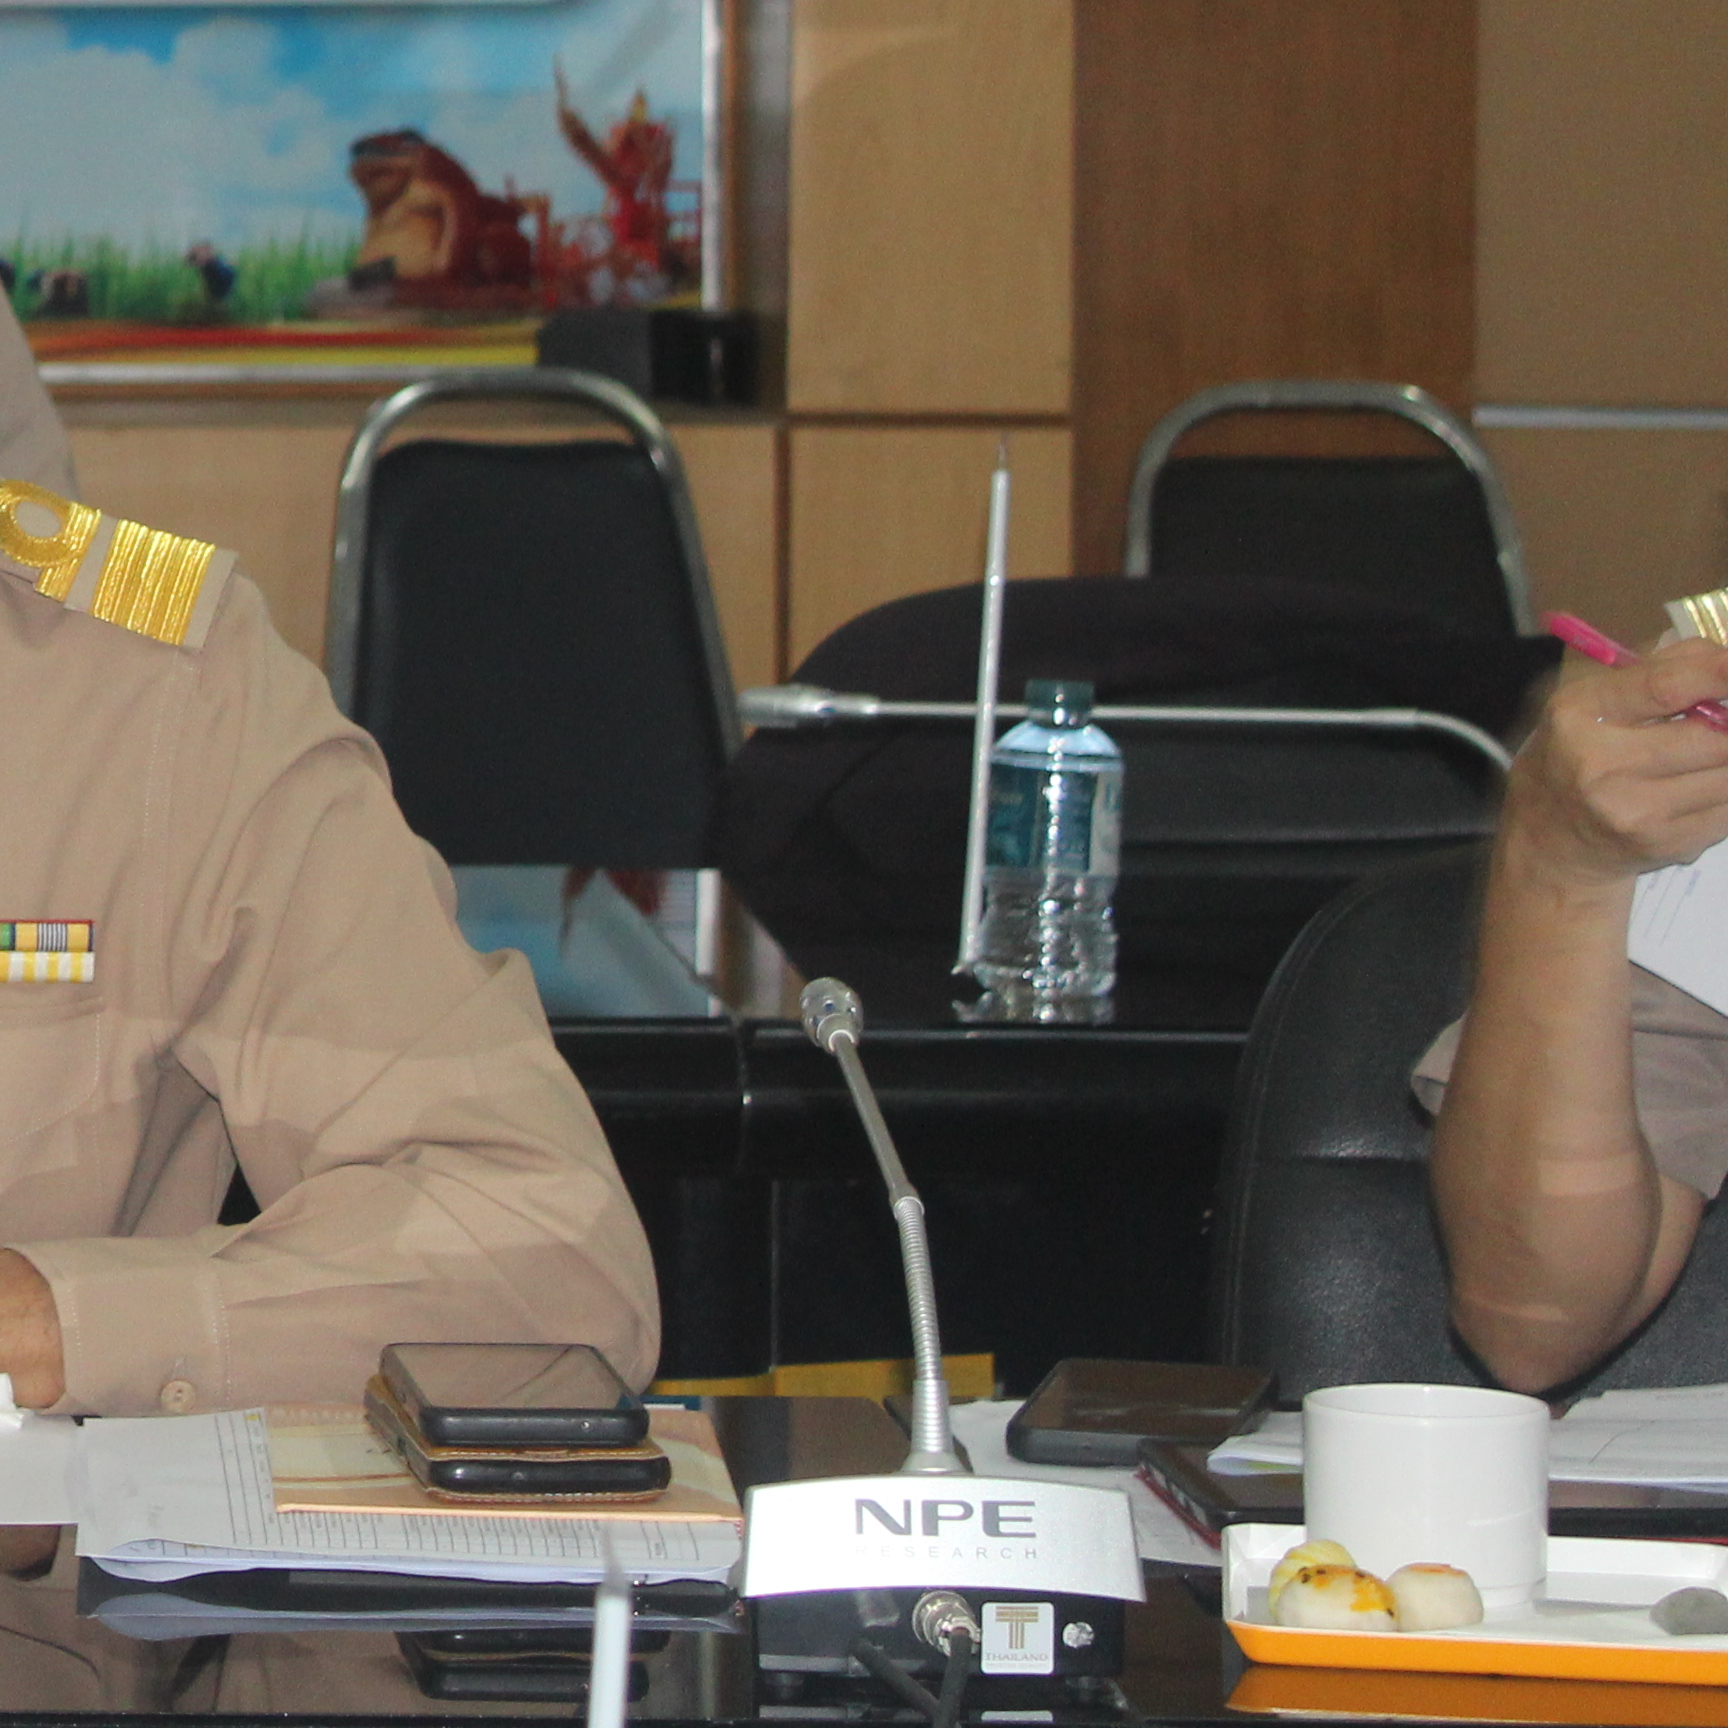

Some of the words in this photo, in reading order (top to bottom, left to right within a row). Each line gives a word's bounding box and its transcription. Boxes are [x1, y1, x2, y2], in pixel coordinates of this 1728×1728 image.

[855, 1498, 1037, 1538] NPE
[855, 1544, 1041, 1561] RESEARCH
[985, 1652, 1049, 1662] THAILAND
